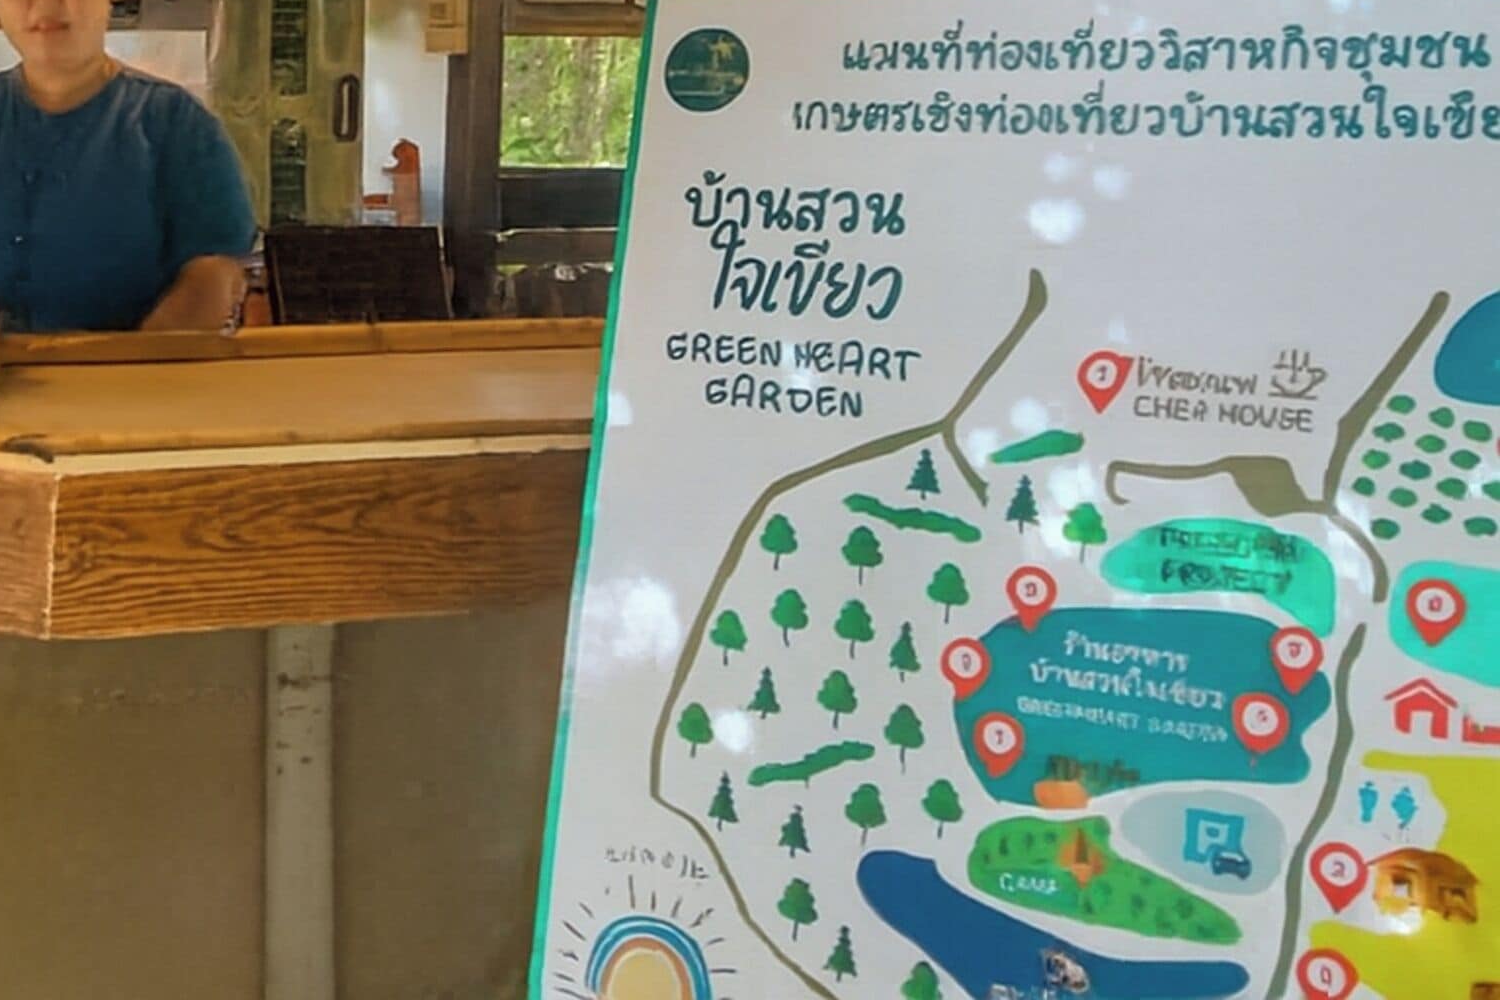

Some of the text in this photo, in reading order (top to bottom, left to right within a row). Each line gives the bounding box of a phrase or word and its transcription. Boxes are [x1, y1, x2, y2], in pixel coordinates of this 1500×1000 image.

[684, 169, 906, 236] บ้านสวน
[709, 218, 903, 321] ใจเขียว
[666, 331, 922, 382] GREEN HEART
[704, 372, 863, 418] GARDEN
